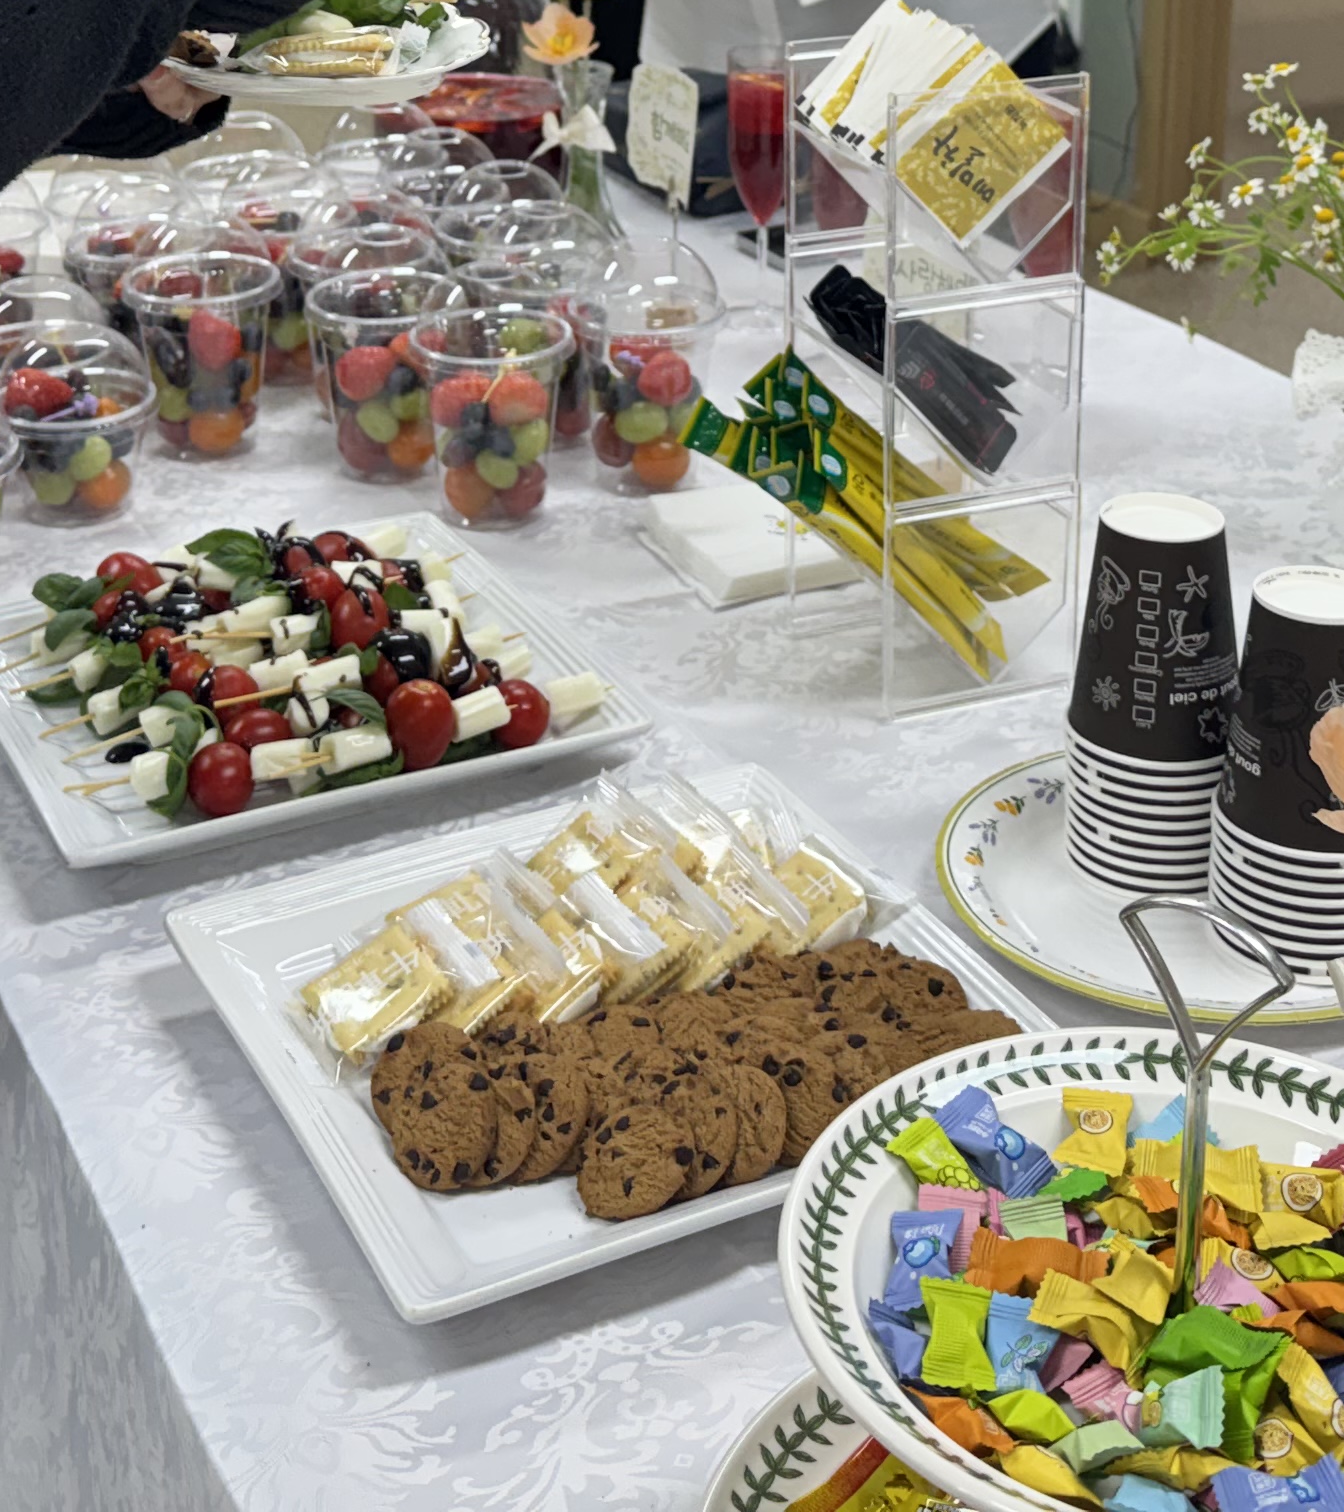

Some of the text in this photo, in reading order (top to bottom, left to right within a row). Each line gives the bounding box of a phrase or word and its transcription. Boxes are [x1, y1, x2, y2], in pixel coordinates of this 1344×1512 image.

[933, 125, 995, 203] 메밀차
[1169, 692, 1198, 706] ciel
[1201, 688, 1218, 701] de
